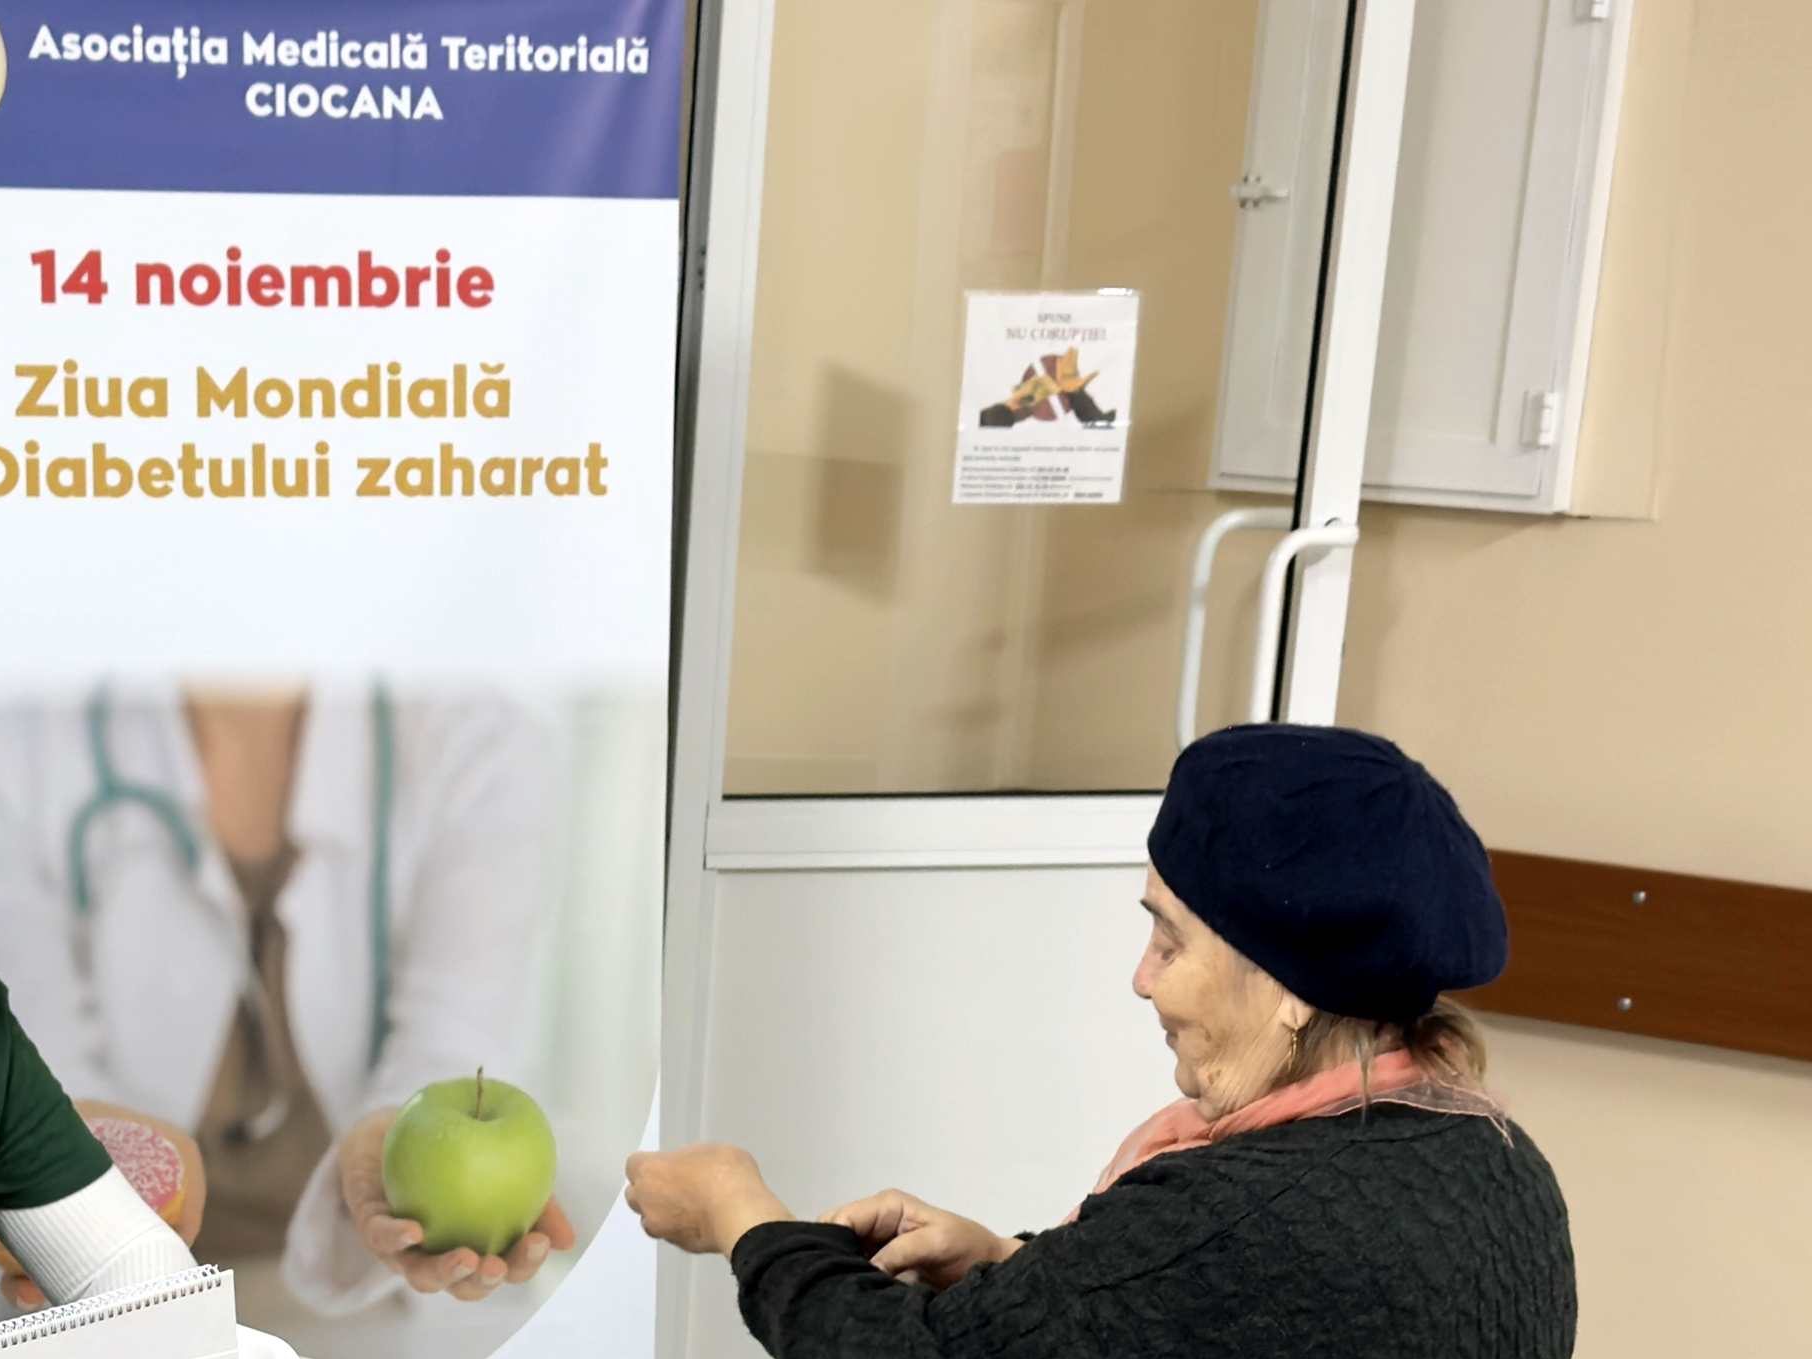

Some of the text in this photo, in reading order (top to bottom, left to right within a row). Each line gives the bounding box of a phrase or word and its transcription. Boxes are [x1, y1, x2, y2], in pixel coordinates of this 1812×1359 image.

[29, 24, 649, 79] Asociația Medicală Teritorială
[245, 82, 443, 120] CIOCANA
[31, 247, 495, 309] 14 noiembrie
[1005, 327, 1027, 340] NU
[15, 359, 511, 419] Ziua Mondială
[356, 443, 609, 497] zaharat
